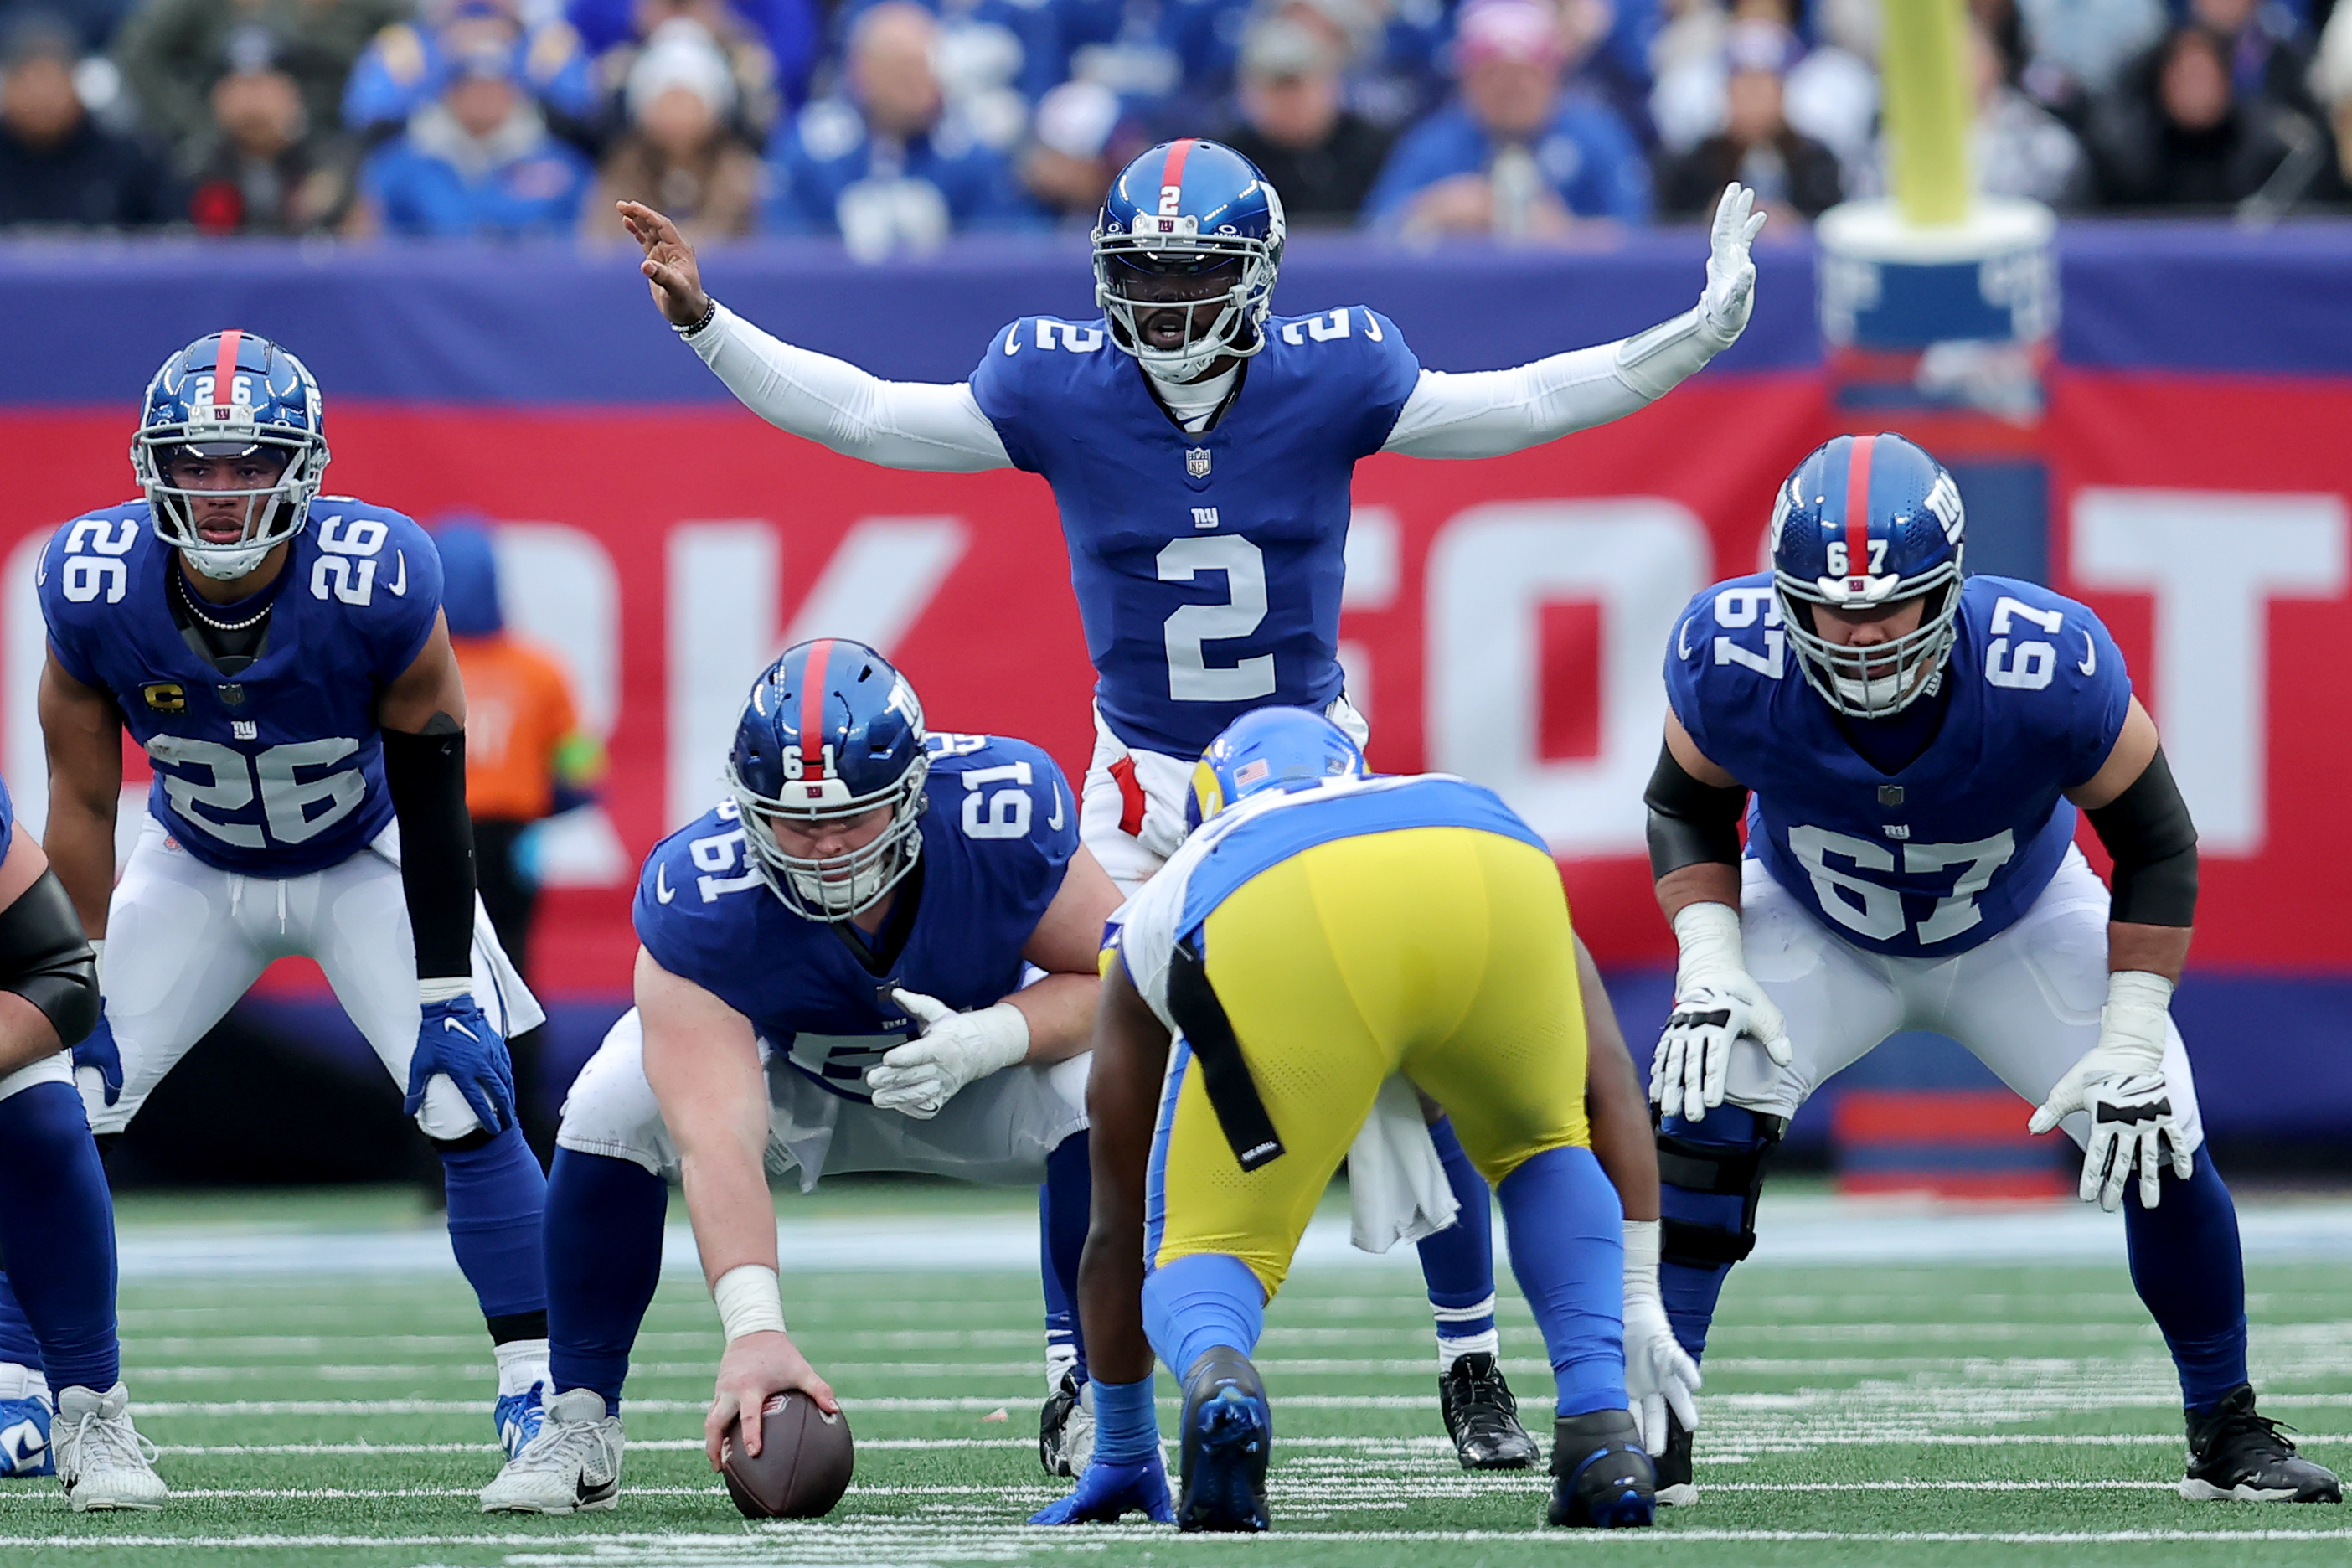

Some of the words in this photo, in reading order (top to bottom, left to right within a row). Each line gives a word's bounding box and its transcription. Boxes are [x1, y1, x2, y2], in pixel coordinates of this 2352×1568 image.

[1158, 185, 1181, 216] 2
[1035, 317, 1104, 353] 2
[1282, 307, 1351, 345] 2
[1190, 506, 1219, 529] ny
[62, 518, 140, 604] 26
[309, 514, 389, 606] 26
[1155, 533, 1277, 702] 2
[1713, 586, 1784, 680] 67
[1983, 596, 2065, 691] 67
[143, 683, 185, 709] C
[230, 720, 258, 740] ny
[143, 732, 367, 849] 26
[960, 759, 1033, 840] 61
[687, 828, 766, 904] 61
[1787, 823, 2016, 946] 67
